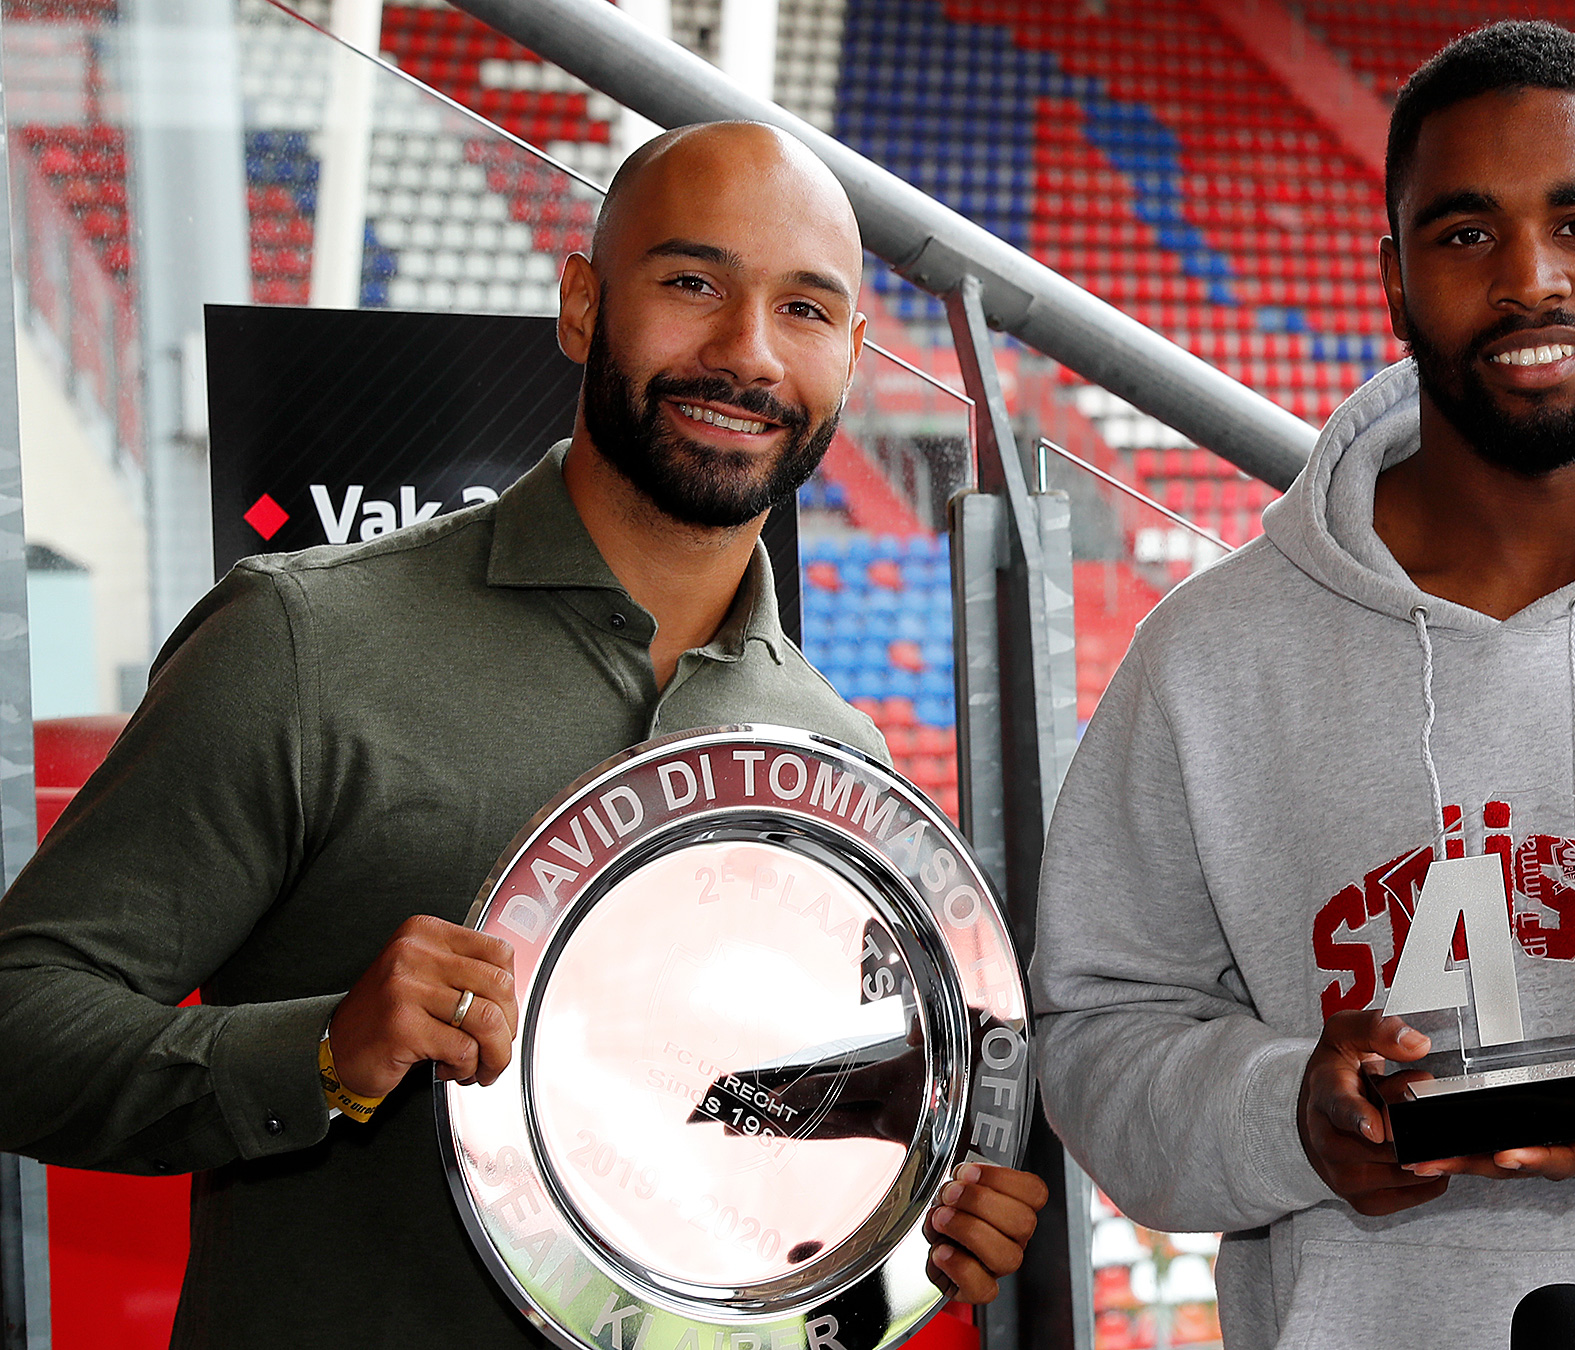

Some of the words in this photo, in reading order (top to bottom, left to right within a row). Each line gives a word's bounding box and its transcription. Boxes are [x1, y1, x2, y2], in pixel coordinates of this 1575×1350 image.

[309, 484, 443, 545] Vak
[497, 784, 645, 944] DAVID
[657, 754, 716, 812] DI
[732, 750, 982, 929] TOMMASO
[961, 955, 1018, 1166] TROFE
[749, 863, 896, 1002] PLAATS
[1524, 935, 1548, 959] di
[663, 1041, 693, 1065] FC
[698, 1060, 798, 1122] UTRECHT
[731, 1107, 787, 1158] 1981
[479, 1144, 593, 1311] SEAN
[566, 1128, 662, 1237] 2019
[687, 1193, 781, 1263] 2020
